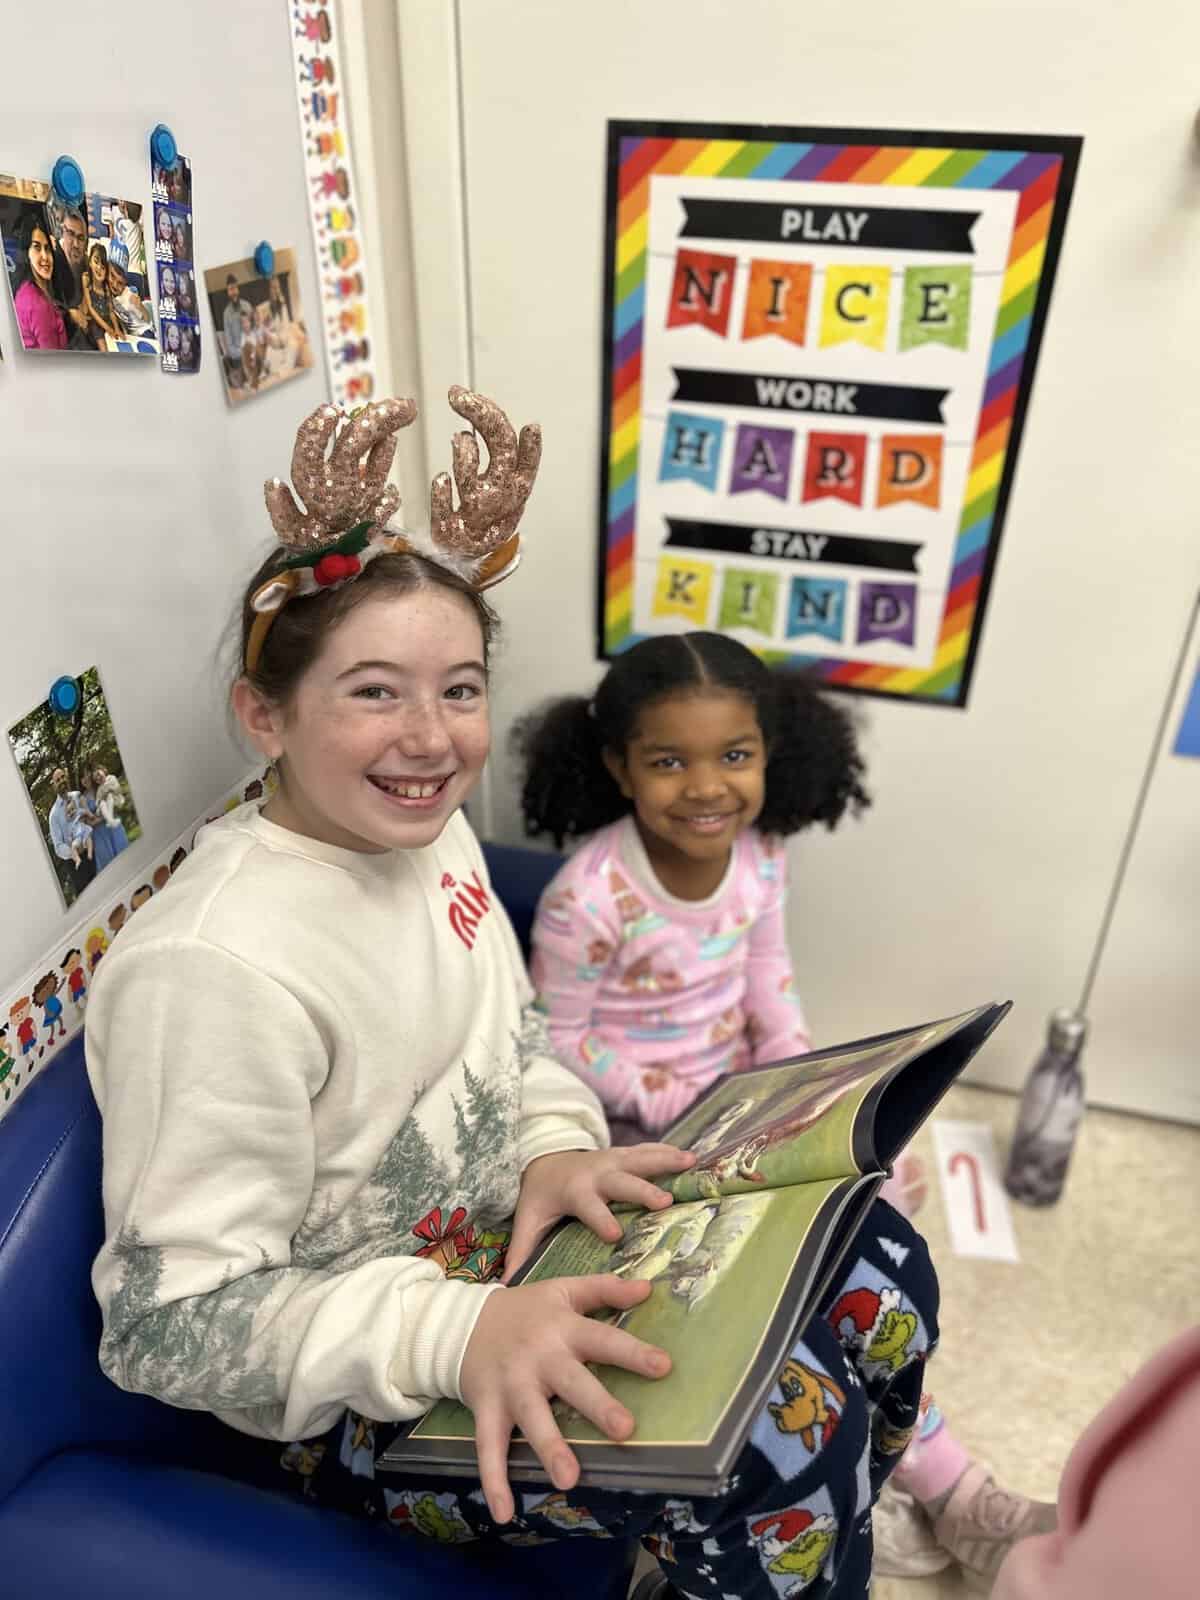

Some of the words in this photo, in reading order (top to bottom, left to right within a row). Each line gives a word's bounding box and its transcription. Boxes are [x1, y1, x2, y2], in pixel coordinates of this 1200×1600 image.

[780, 208, 869, 242] PLAY
[677, 265, 954, 325] NICE
[754, 377, 859, 414] WORK
[669, 425, 931, 488] HARD
[749, 528, 829, 560] STAY
[666, 568, 905, 630] KIND
